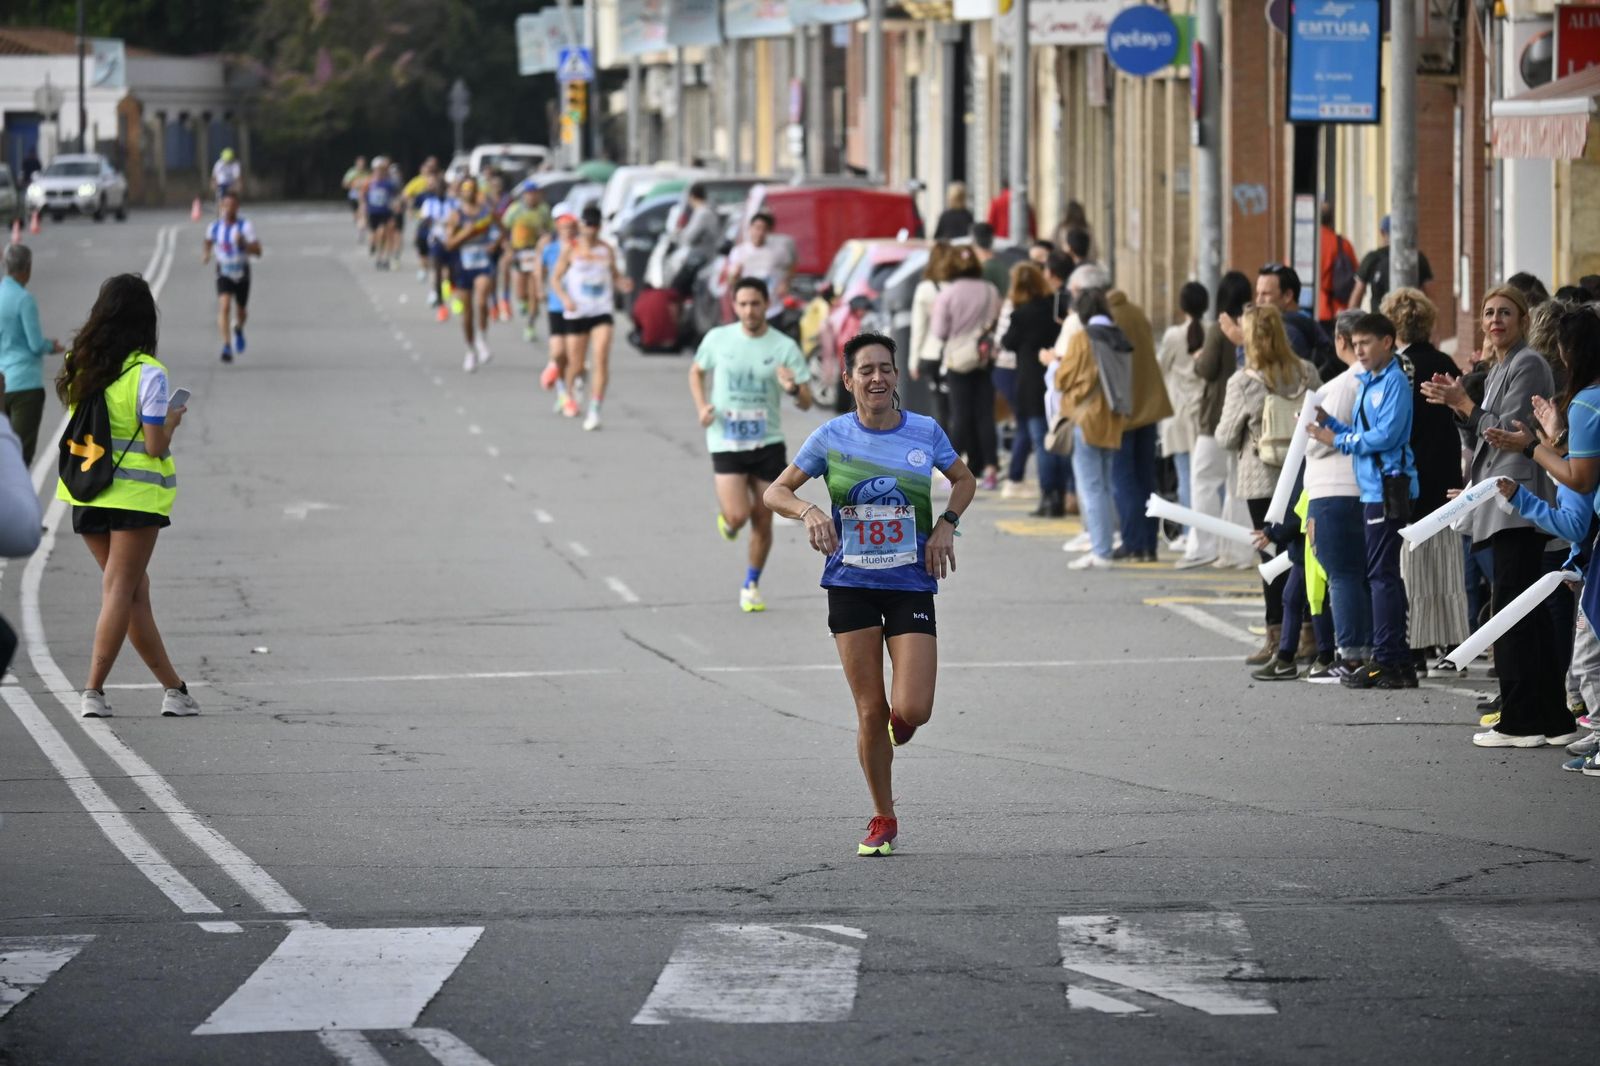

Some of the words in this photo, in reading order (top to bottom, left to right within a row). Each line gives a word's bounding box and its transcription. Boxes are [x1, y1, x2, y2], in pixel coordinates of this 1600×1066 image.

[1297, 21, 1370, 36] EMTUSA
[1111, 28, 1172, 52] pelayo
[730, 420, 760, 436] 163
[854, 520, 904, 546] 183
[861, 554, 895, 565] Huelva
